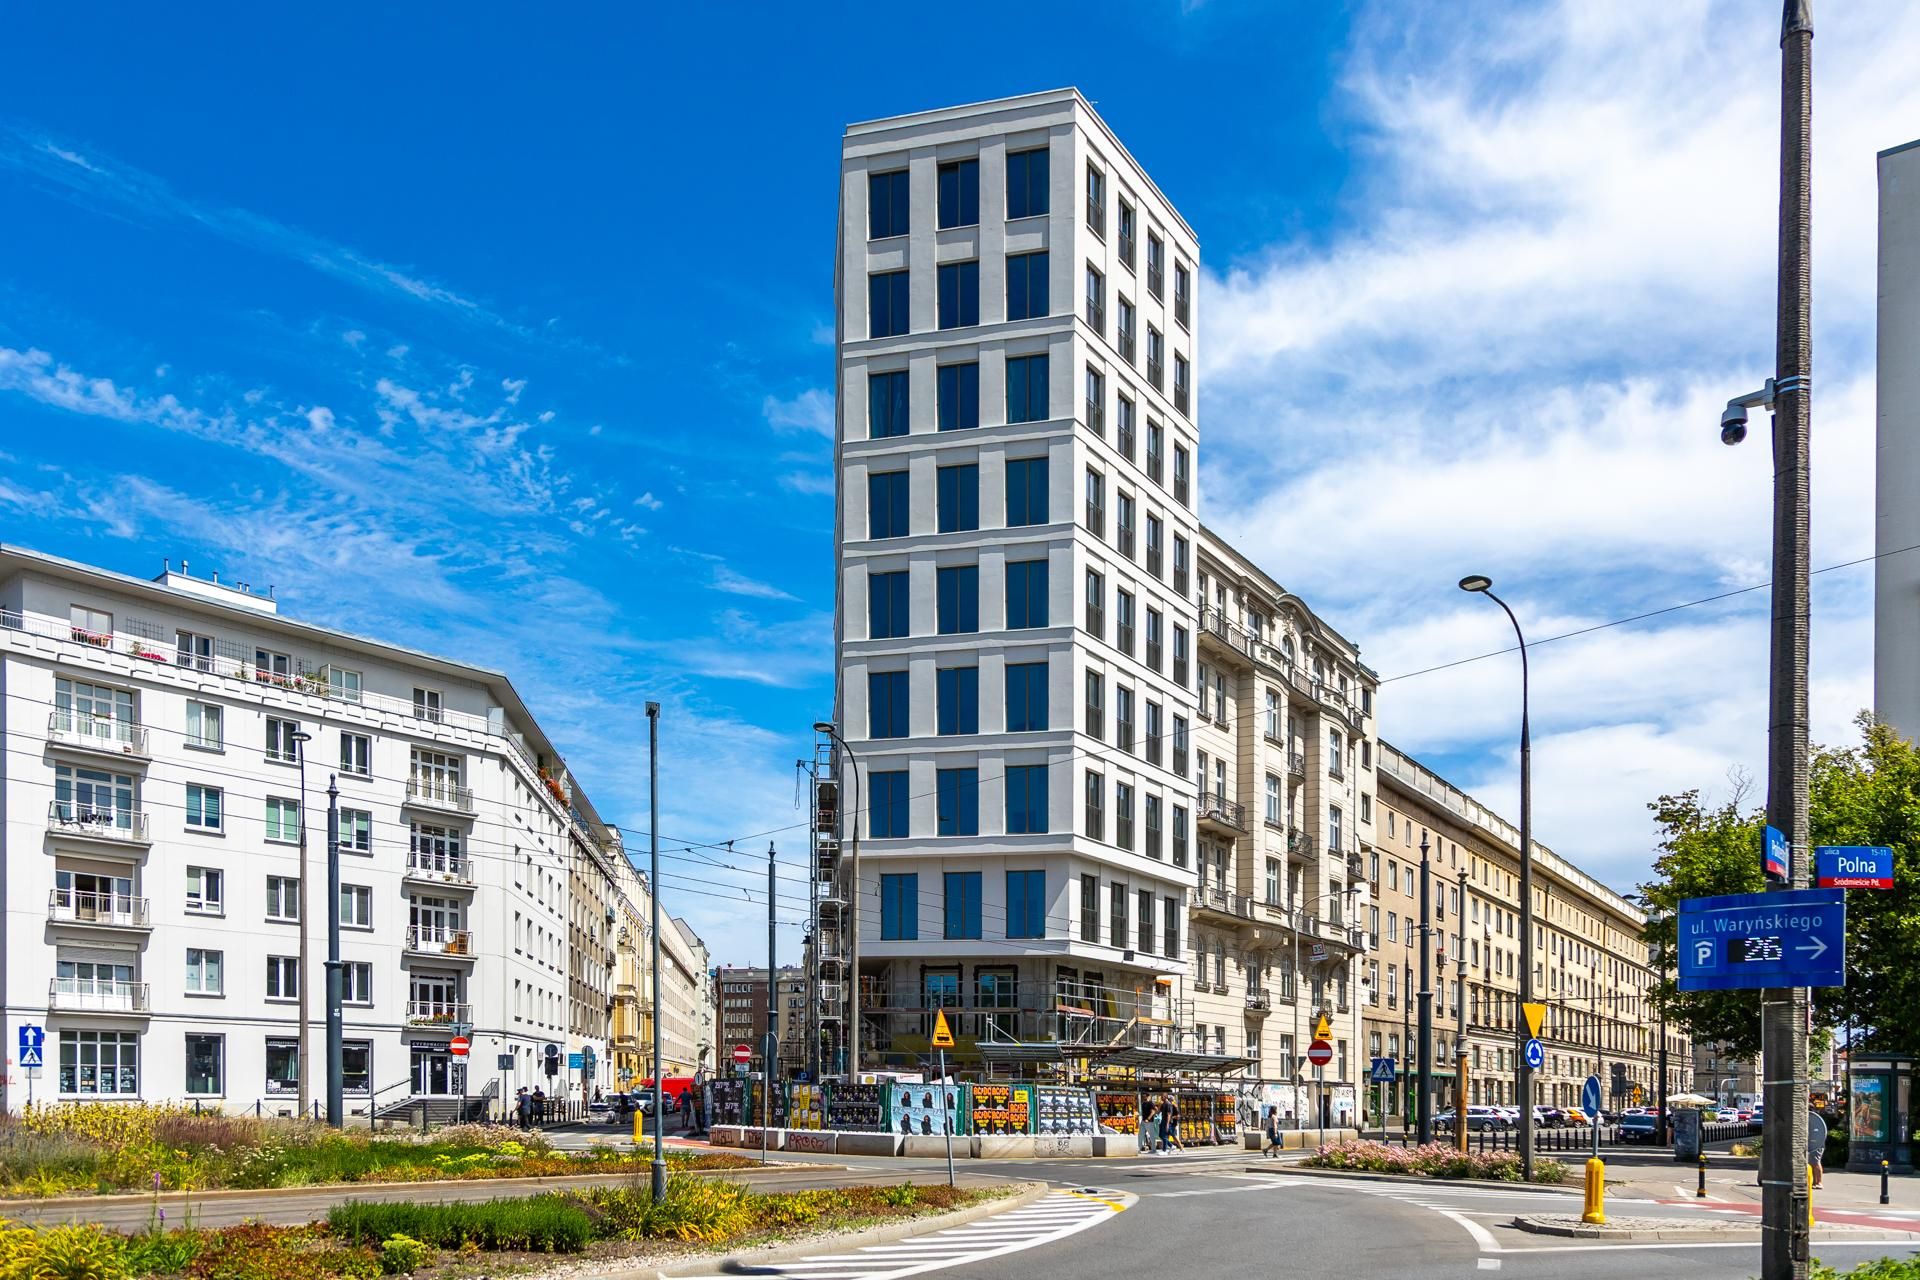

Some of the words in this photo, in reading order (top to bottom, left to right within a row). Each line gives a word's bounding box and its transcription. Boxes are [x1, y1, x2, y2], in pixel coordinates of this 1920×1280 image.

[1871, 848, 1887, 856] 15-11
[1838, 856, 1876, 873] Polna
[1691, 919, 1709, 934] ul.
[1713, 914, 1823, 934] Waryńskiego
[1698, 947, 1712, 965] P
[1744, 936, 1783, 962] 26
